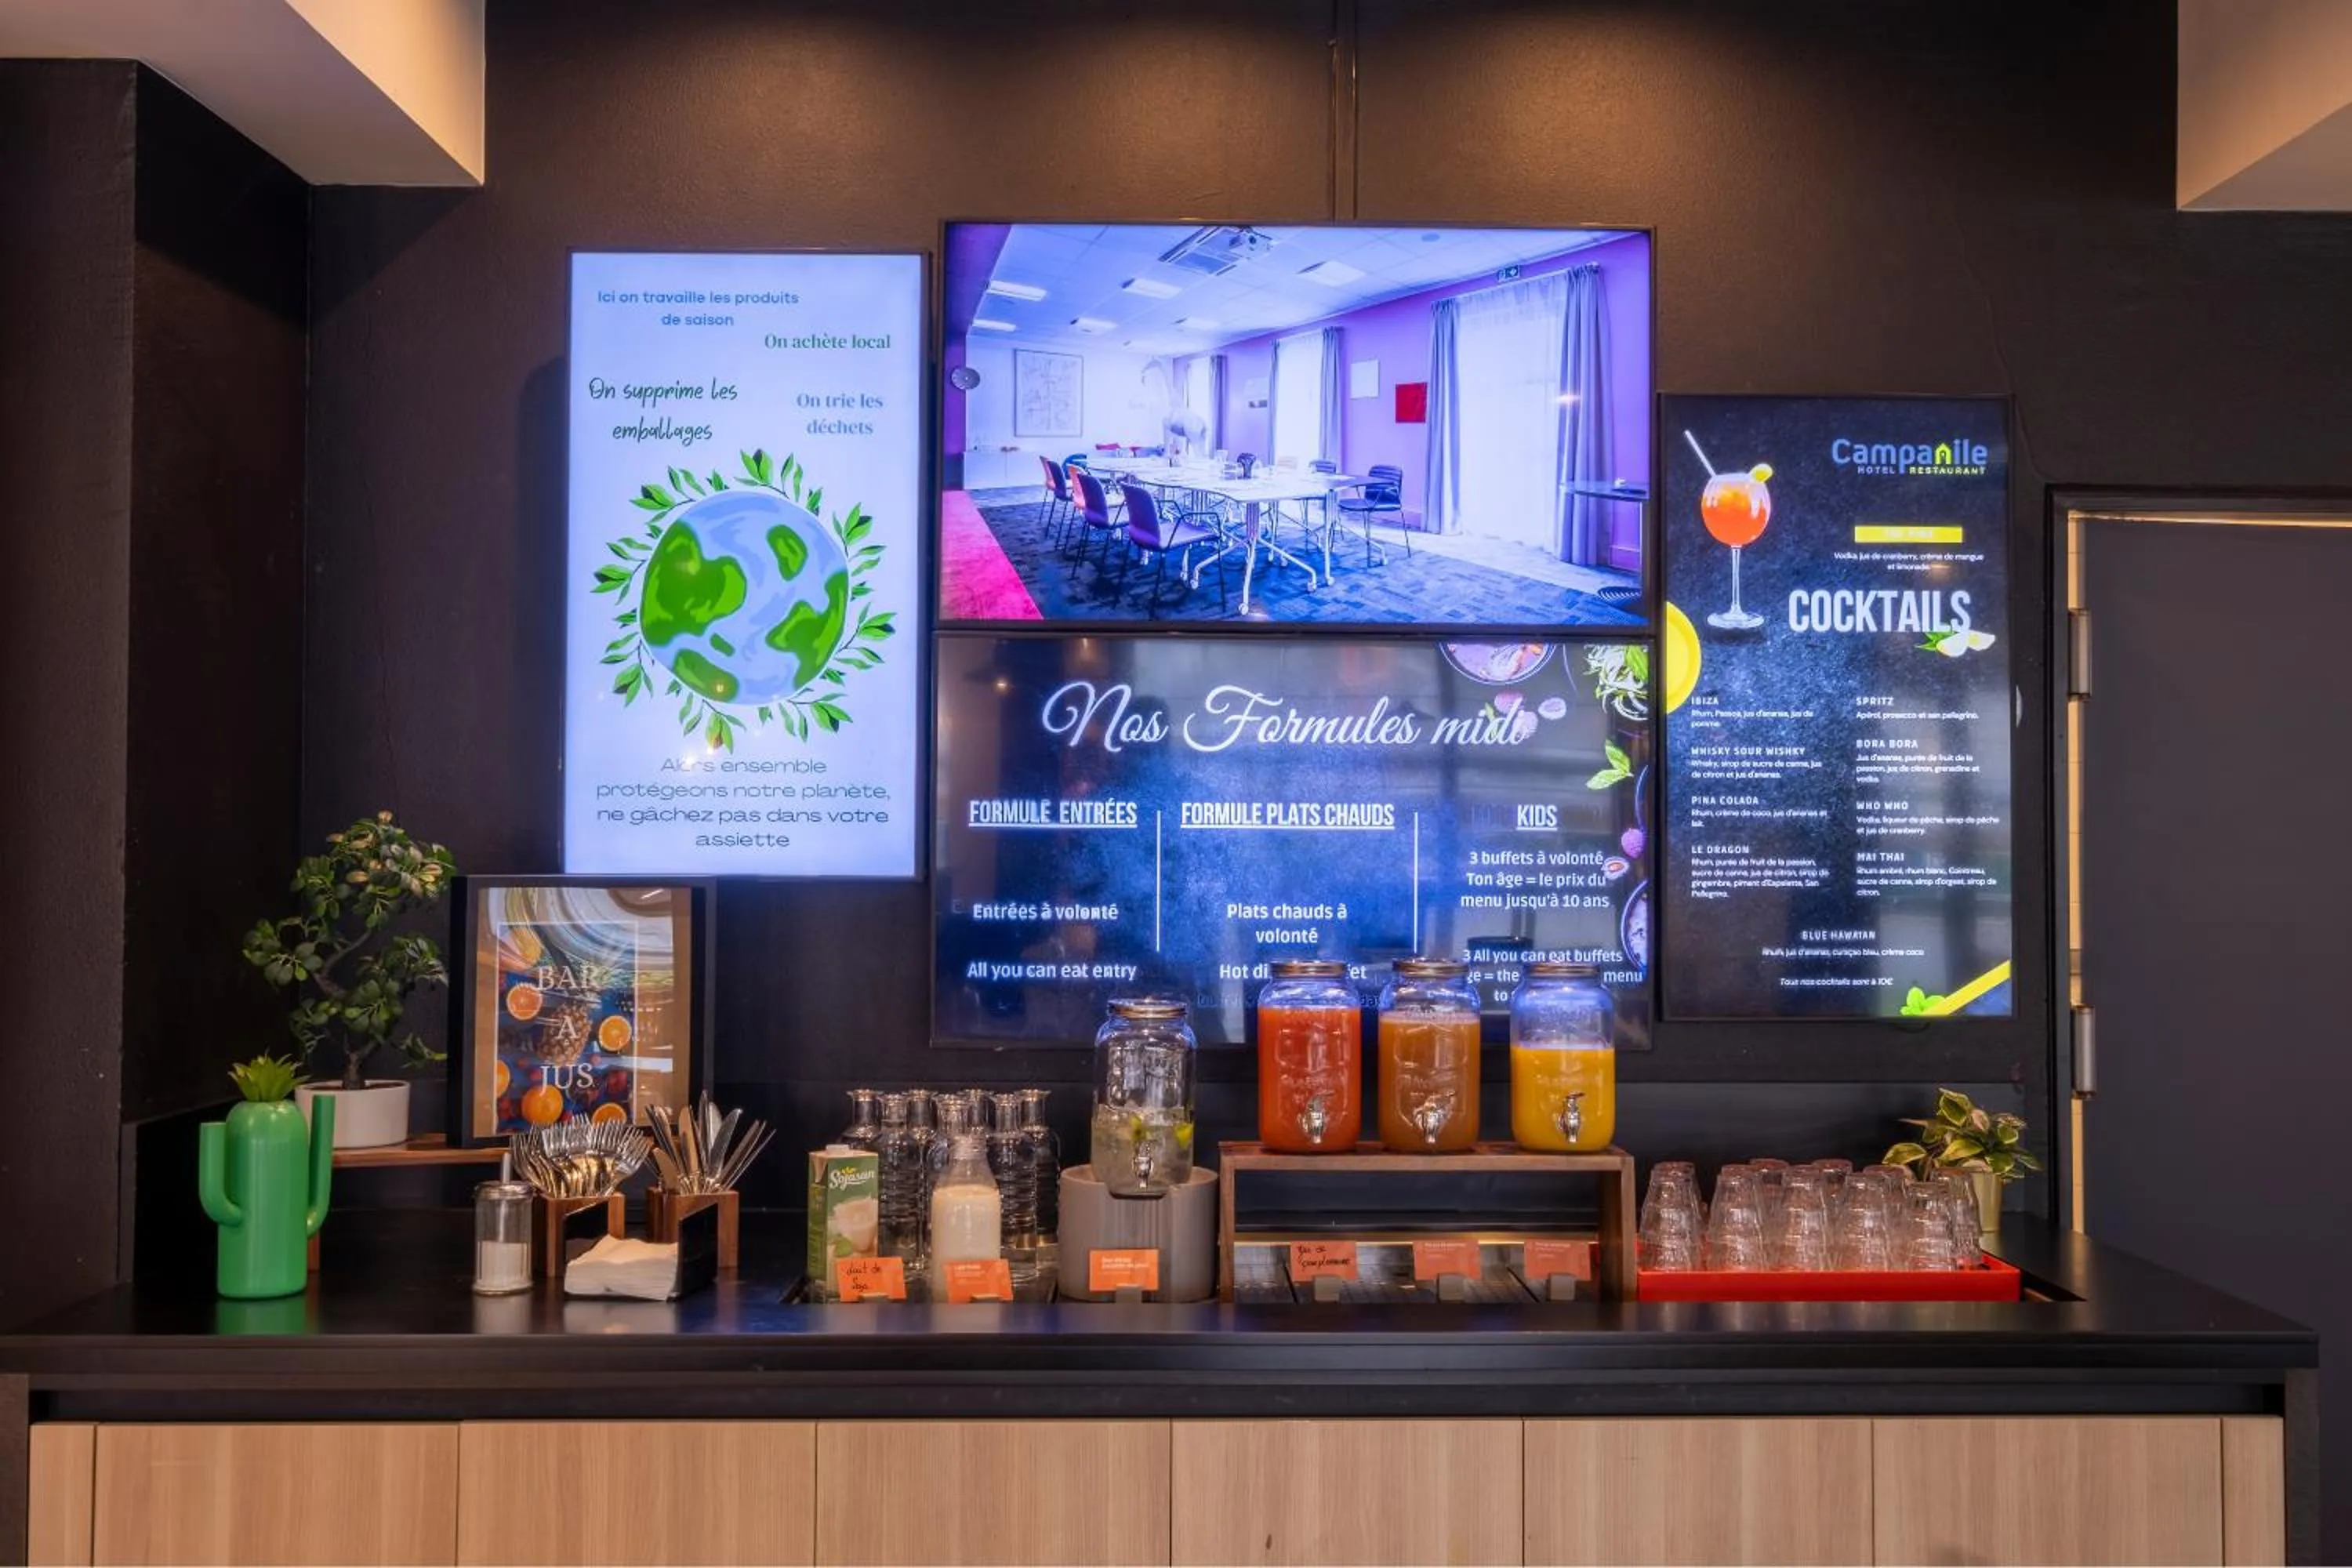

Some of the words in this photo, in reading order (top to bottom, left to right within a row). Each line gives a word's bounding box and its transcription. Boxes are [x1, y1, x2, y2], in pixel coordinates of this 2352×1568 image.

[598, 291, 615, 304] Ici
[619, 293, 639, 303] on
[643, 291, 706, 304] travaille
[710, 291, 731, 304] les
[735, 291, 800, 306] produits
[661, 314, 681, 326] de
[684, 314, 734, 326] saison
[764, 333, 788, 350] On
[792, 333, 848, 350] achète
[851, 333, 891, 350] local
[589, 377, 615, 400] On
[623, 379, 703, 409] supprime
[711, 377, 738, 400] les
[797, 393, 821, 408] On
[825, 393, 856, 408] trie
[860, 393, 884, 408] les
[612, 416, 713, 447] emballages
[807, 418, 873, 435] déchets
[1831, 439, 1988, 475] Campanile
[1857, 466, 1896, 475] HOTEL
[1909, 466, 1987, 475] RESTAURANT
[1789, 590, 1972, 633] COCKTAILS
[1691, 696, 1719, 706] IBIZA
[1856, 697, 1894, 706] SPRITZ
[1041, 680, 1169, 754] Nos
[1182, 684, 1421, 753] Formules
[1691, 746, 1730, 755] WHISKY
[1734, 746, 1762, 755] SOUR
[1856, 739, 1886, 749] BORA
[1889, 739, 1918, 749] BORA
[660, 757, 715, 772] Alrs
[720, 757, 826, 773] ensemble
[597, 782, 728, 801] protégeons
[733, 785, 796, 798] notre
[801, 782, 891, 801] planète,
[1691, 796, 1716, 805] PINA
[1719, 796, 1759, 805] COLADA
[1856, 800, 1881, 810] WHO
[1884, 800, 1909, 810] WHO
[597, 810, 625, 822] ne
[629, 807, 713, 826] gâchez
[719, 811, 761, 825] pas
[767, 809, 822, 823] dans
[827, 810, 889, 823] votre
[969, 800, 1051, 825] FORMULE
[1059, 797, 1137, 825] ENTRÉES
[1181, 802, 1261, 826] FORMULE
[1267, 802, 1320, 826] PLATS
[1325, 802, 1395, 826] CHAUDS
[1517, 804, 1558, 827] KIDS
[695, 832, 790, 848] assiette
[1470, 851, 1478, 865] 3
[1482, 851, 1534, 865] buffets
[1537, 851, 1546, 865] à
[1549, 851, 1603, 865] volonté
[1691, 845, 1704, 854] LE
[1707, 845, 1750, 854] DRAGON
[1856, 852, 1876, 862] MAI
[1880, 852, 1905, 862] THAI
[1467, 872, 1492, 887] Ton
[1497, 872, 1523, 889] âge
[1539, 872, 1553, 887] le
[1556, 872, 1584, 890] prix
[1588, 872, 1606, 887] du
[1461, 895, 1501, 909] menu
[1505, 893, 1559, 911] jusqu'à
[1563, 895, 1579, 908] 10
[1584, 895, 1609, 909] ans
[973, 903, 1037, 920] Entrées
[1040, 903, 1052, 920] à
[1055, 903, 1119, 920] volonté
[1227, 903, 1269, 920] Plats
[1272, 903, 1333, 920] chauds
[1337, 903, 1348, 920] à
[1256, 927, 1318, 944] volonté
[1802, 931, 1828, 940] BLUE
[1463, 949, 1471, 963] 3
[1473, 949, 1490, 963] All
[1493, 952, 1518, 964] you
[1521, 951, 1545, 962] can
[1549, 950, 1571, 962] eat
[1574, 949, 1623, 963] buffets
[535, 965, 601, 991] BAR
[967, 963, 988, 980] All
[992, 967, 1022, 983] you
[1026, 966, 1056, 979] can
[1061, 963, 1088, 980] eat
[1093, 964, 1137, 983] entry
[1219, 964, 1248, 979] Hot
[1467, 971, 1481, 984] ge
[1497, 970, 1519, 982] the
[1603, 971, 1642, 982] menu
[1494, 990, 1508, 1001] to
[557, 1016, 580, 1039] A
[539, 1062, 593, 1096] JUS
